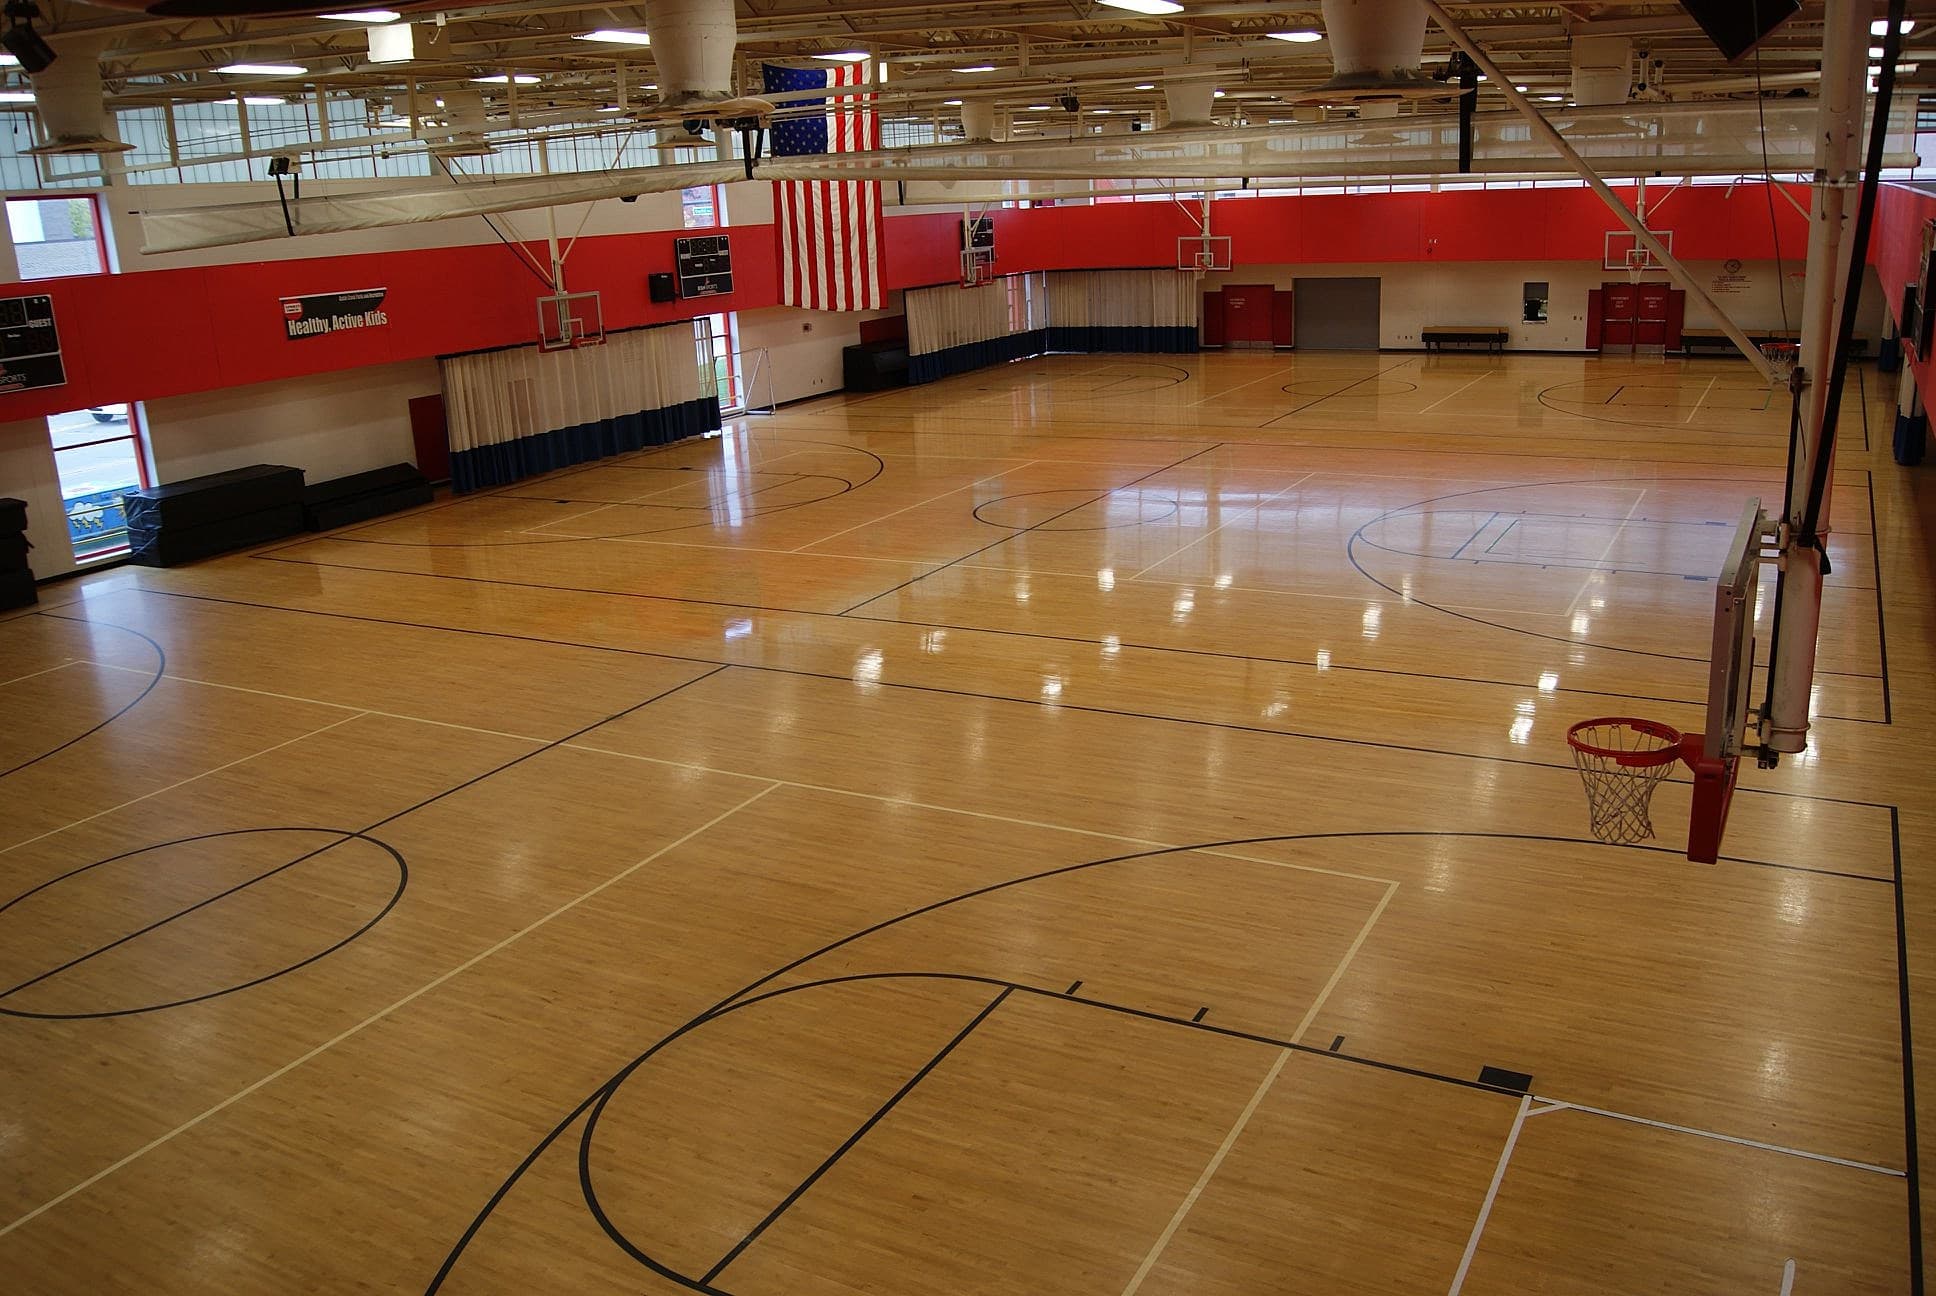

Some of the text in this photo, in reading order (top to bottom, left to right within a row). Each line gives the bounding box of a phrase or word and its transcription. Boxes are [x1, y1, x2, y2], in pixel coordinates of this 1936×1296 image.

[288, 310, 388, 336] Healthy, Active Kids
